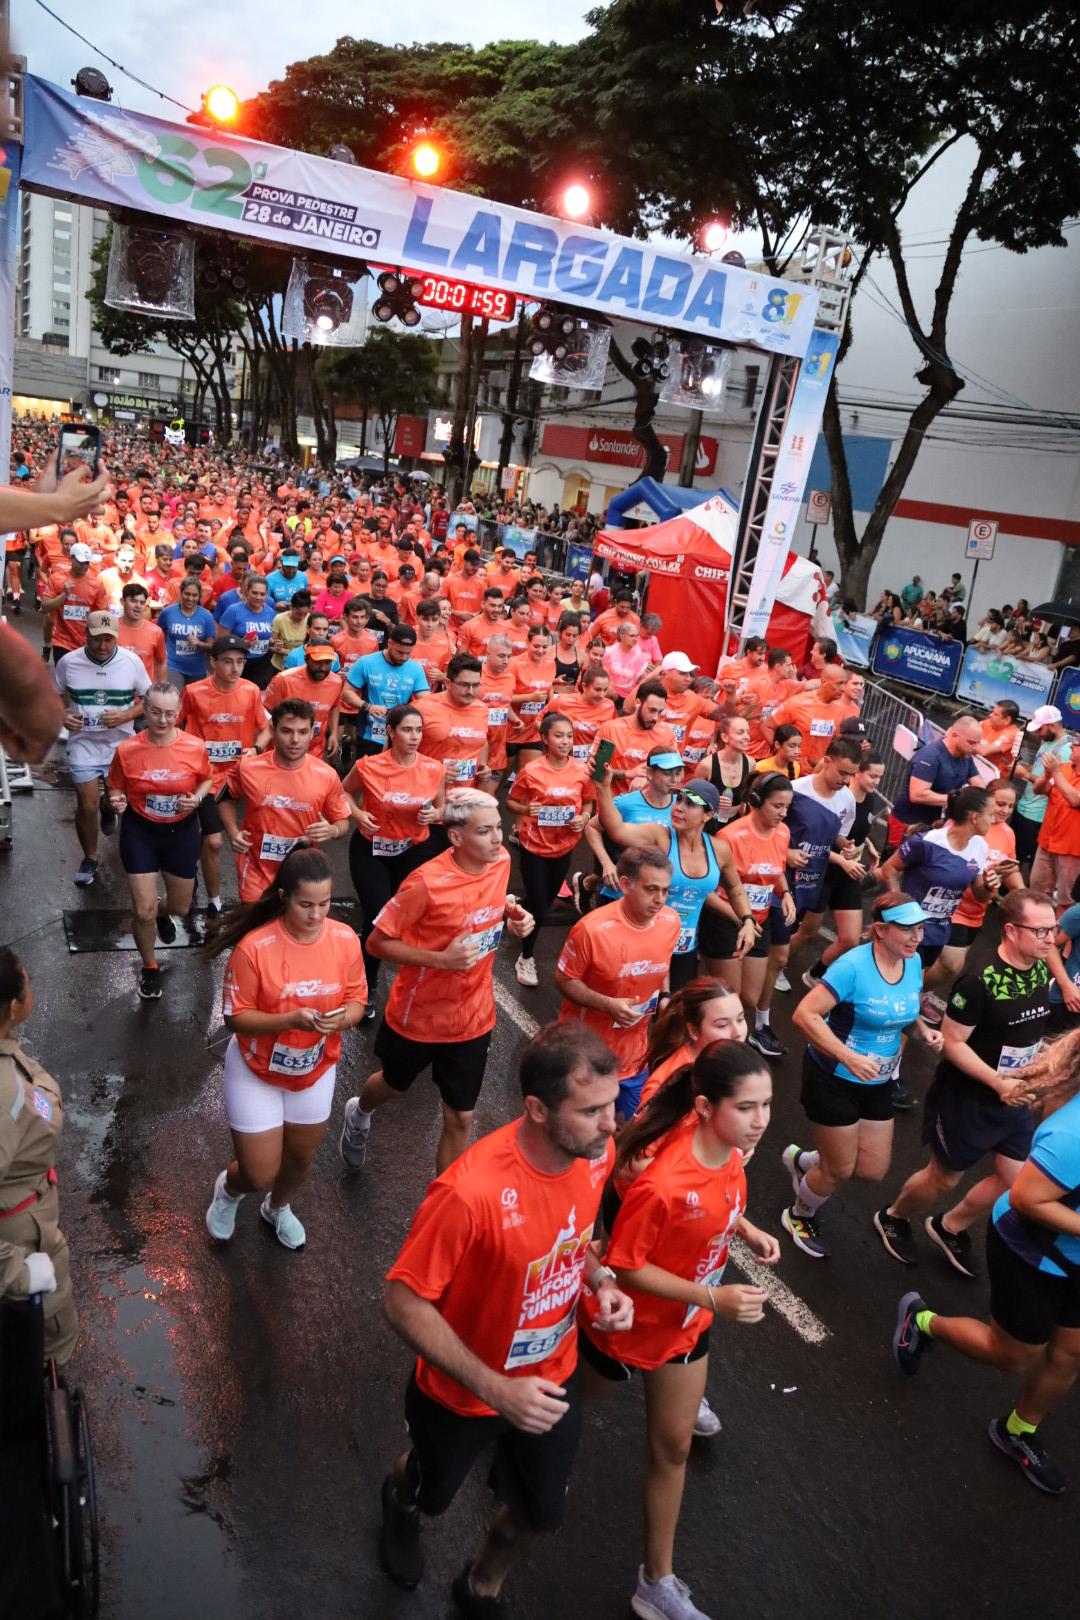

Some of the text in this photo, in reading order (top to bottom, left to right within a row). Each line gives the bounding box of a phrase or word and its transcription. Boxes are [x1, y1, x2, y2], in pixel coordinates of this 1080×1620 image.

[252, 186, 355, 219] PROVA PEDESTRE
[245, 203, 379, 247] 28 de JANEIRO
[402, 195, 728, 329] LARGADA
[599, 438, 640, 456] Santander
[816, 495, 823, 504] E
[979, 526, 988, 536] E
[904, 645, 950, 665] APUCARANA
[212, 748, 236, 756] 5330
[544, 812, 570, 820] 6565
[1021, 1006, 1045, 1018] TEAM
